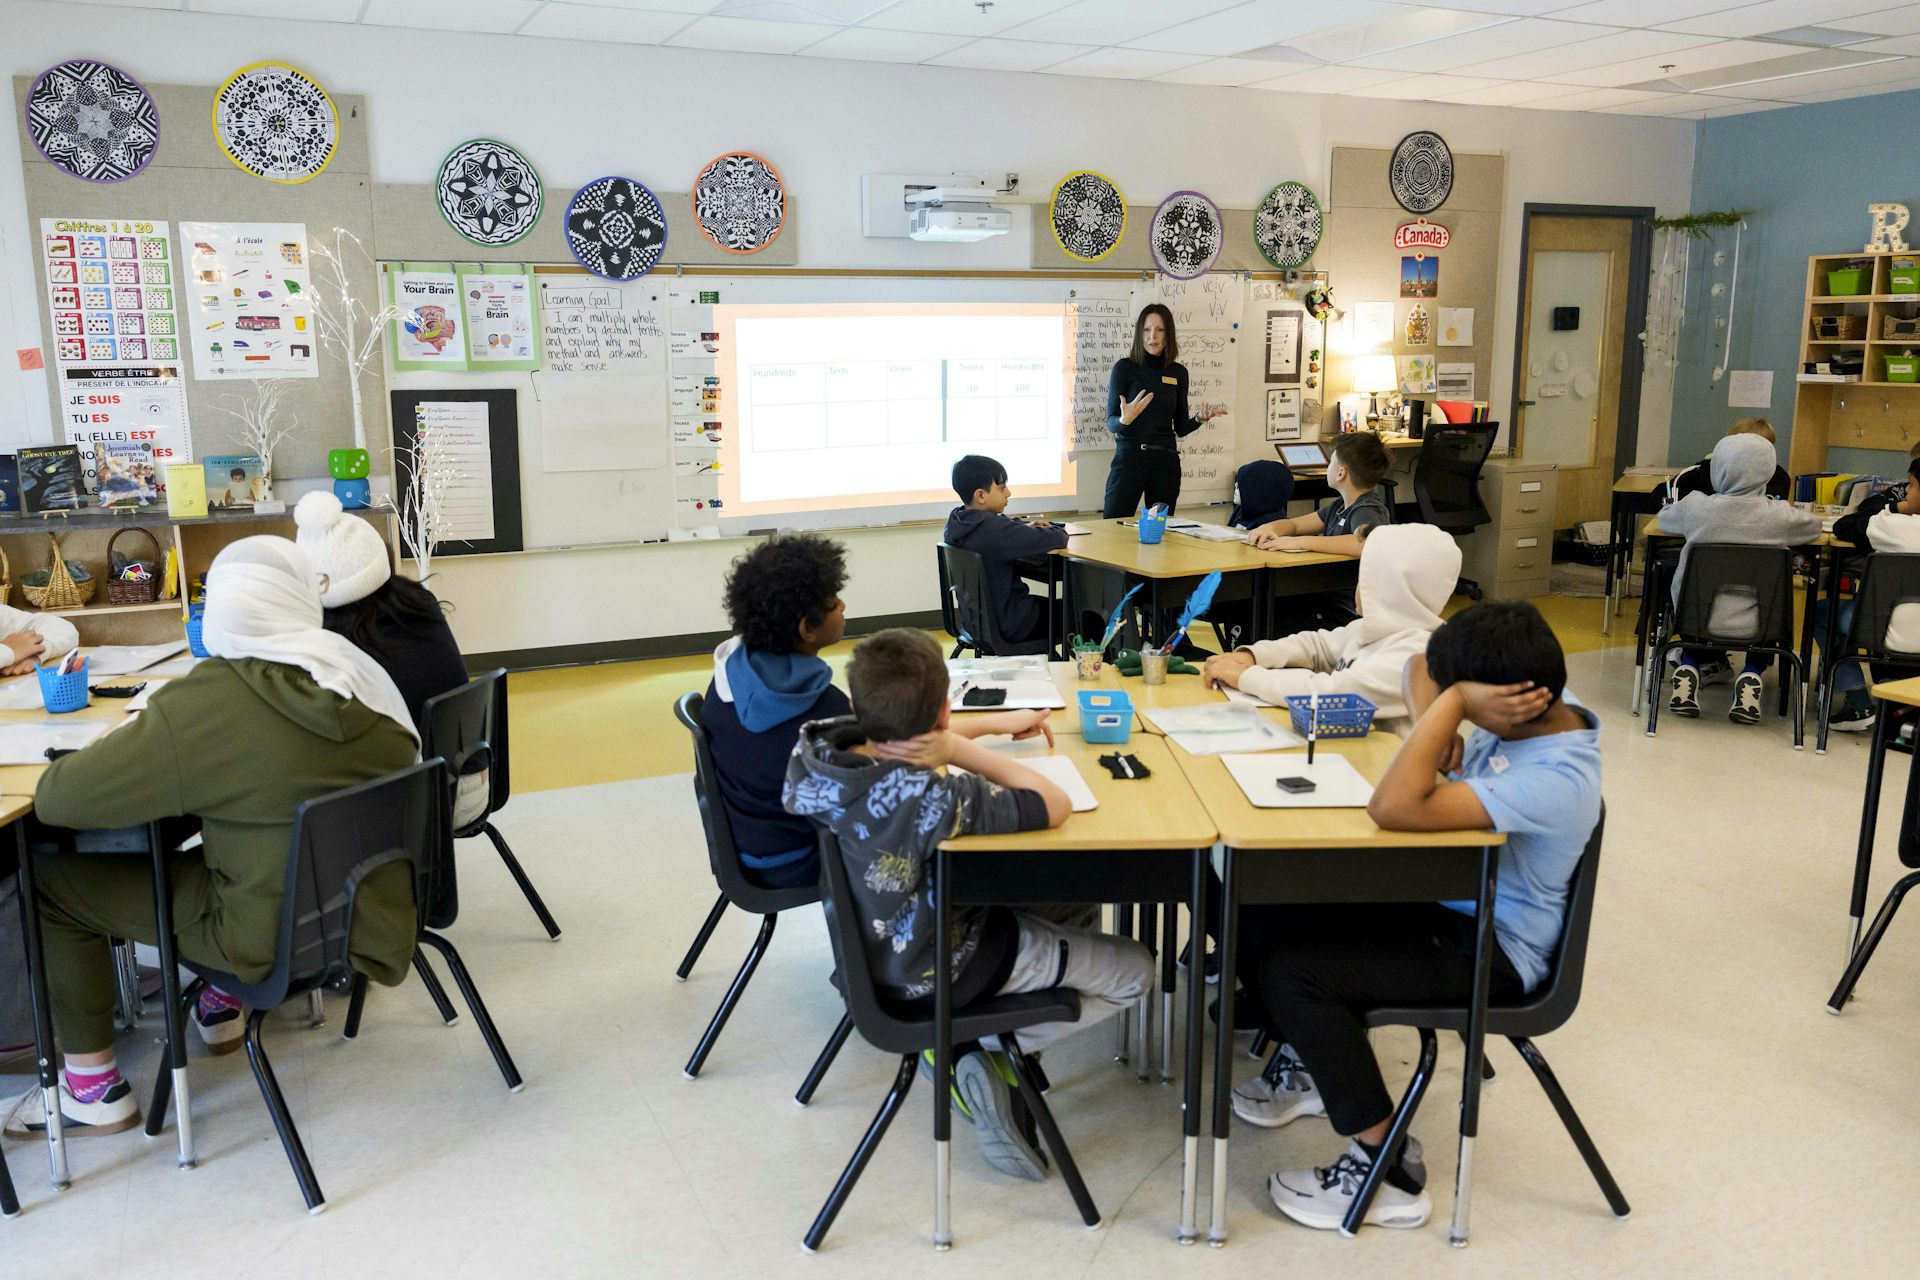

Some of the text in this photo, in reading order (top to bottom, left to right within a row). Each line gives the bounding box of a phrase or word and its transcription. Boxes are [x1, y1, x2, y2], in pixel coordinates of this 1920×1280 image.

[55, 221, 153, 234] Chiffres 1 à 20
[1864, 203, 1910, 254] R
[1402, 227, 1442, 245] Canada
[404, 284, 454, 294] Your Brain
[546, 291, 611, 312] Learning Goal
[1096, 300, 1122, 313] Criteria
[555, 309, 658, 325] I can multiply whole
[545, 323, 665, 338] numbers by decimal tenths
[1098, 319, 1121, 332] multiply
[1073, 329, 1095, 338] number
[1099, 329, 1107, 342] by
[1122, 330, 1132, 339] and
[546, 333, 641, 355] and explain why my
[1082, 339, 1096, 348] whole
[1201, 336, 1220, 351] Steps
[548, 348, 648, 360] method and answers
[1082, 354, 1098, 363] know
[1102, 354, 1113, 363] that
[552, 360, 574, 372] make
[890, 365, 912, 373] Ones
[1001, 362, 1045, 371] Hundredths
[1191, 358, 1204, 368] first
[128, 368, 154, 377] ÊTRE
[753, 368, 797, 377] Hundreds
[1076, 374, 1089, 383] than
[1082, 384, 1096, 392] know
[1191, 378, 1208, 392] bridge
[1215, 378, 1222, 387] to
[70, 395, 120, 405] JE SUIS
[72, 414, 110, 423] TU ES
[74, 431, 156, 442] IL (ELLE) EST
[1070, 435, 1097, 448] multiply
[79, 451, 96, 460] NO
[1201, 444, 1223, 460] syllable
[1182, 467, 1217, 478] and blend
